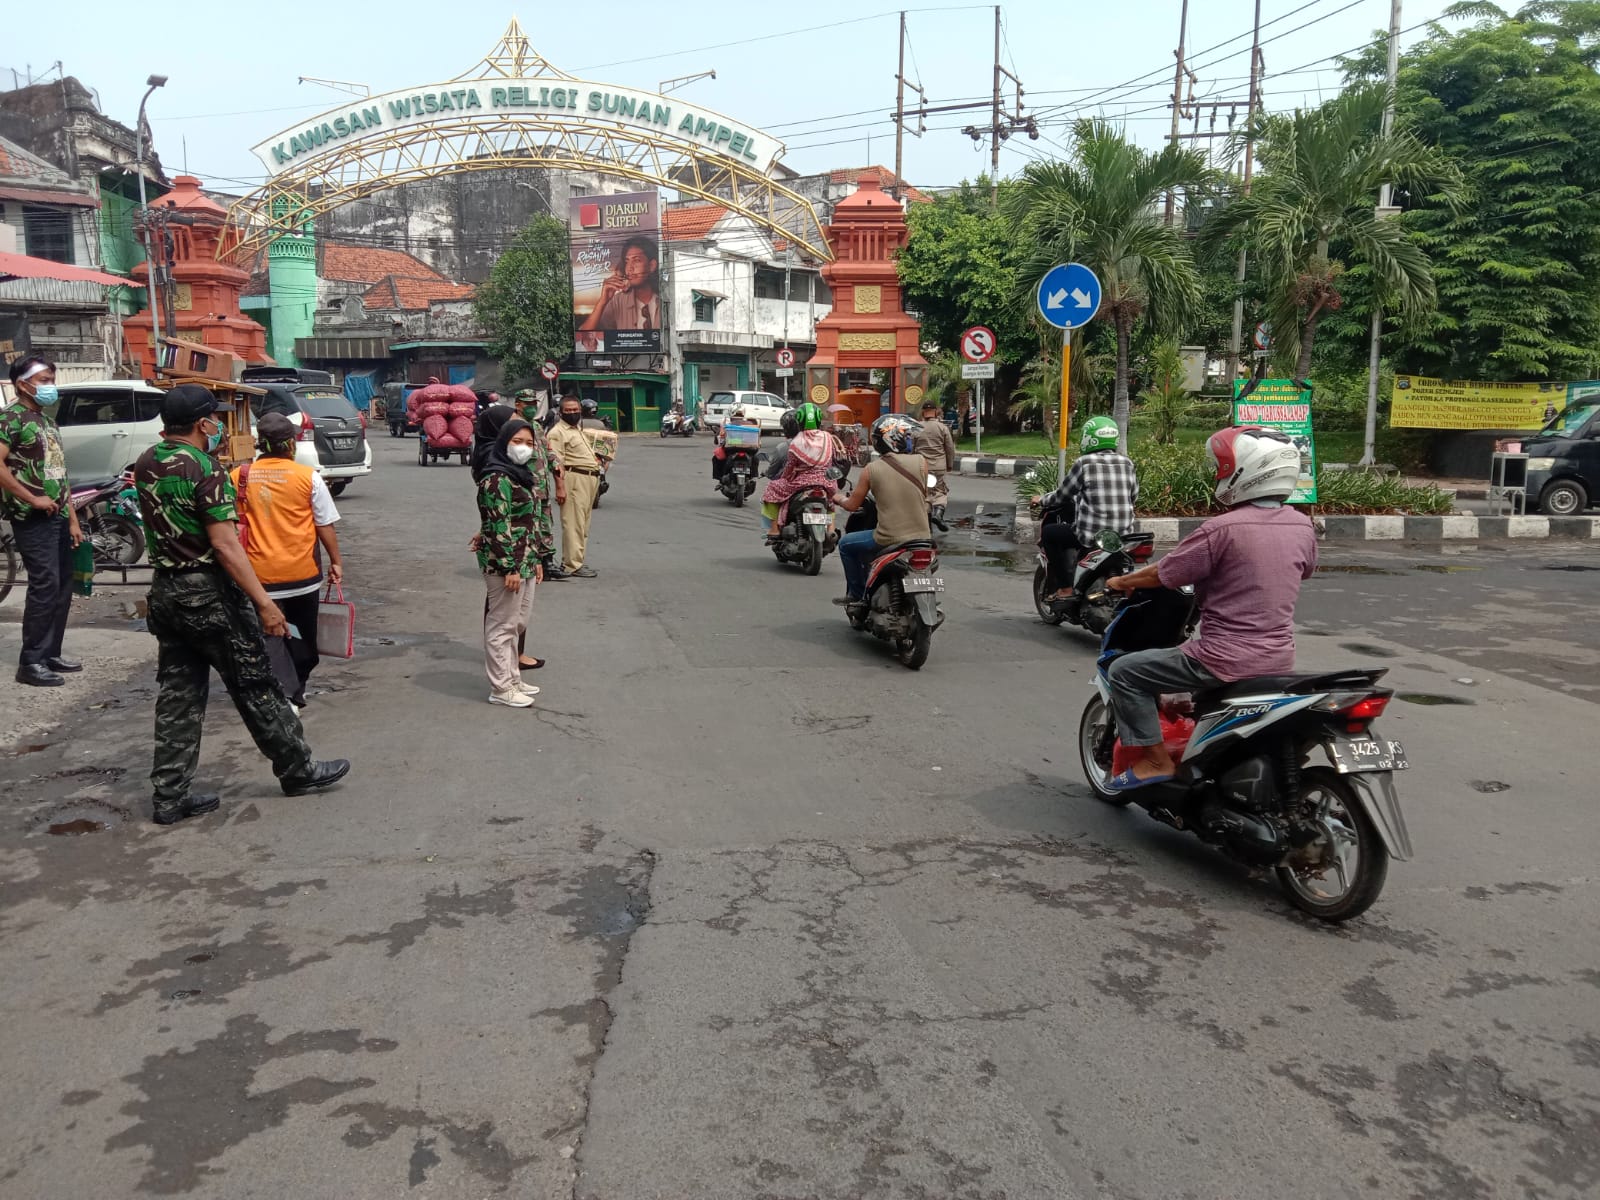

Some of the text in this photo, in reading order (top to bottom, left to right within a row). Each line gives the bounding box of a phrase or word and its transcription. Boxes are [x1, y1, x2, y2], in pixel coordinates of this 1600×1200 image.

[271, 86, 758, 165] KAWASAN WISATA RELIGI SUNAN AMPEL
[605, 202, 649, 216] DJARUM
[606, 215, 639, 228] SUPER
[1330, 741, 1403, 758] L 3425 RS
